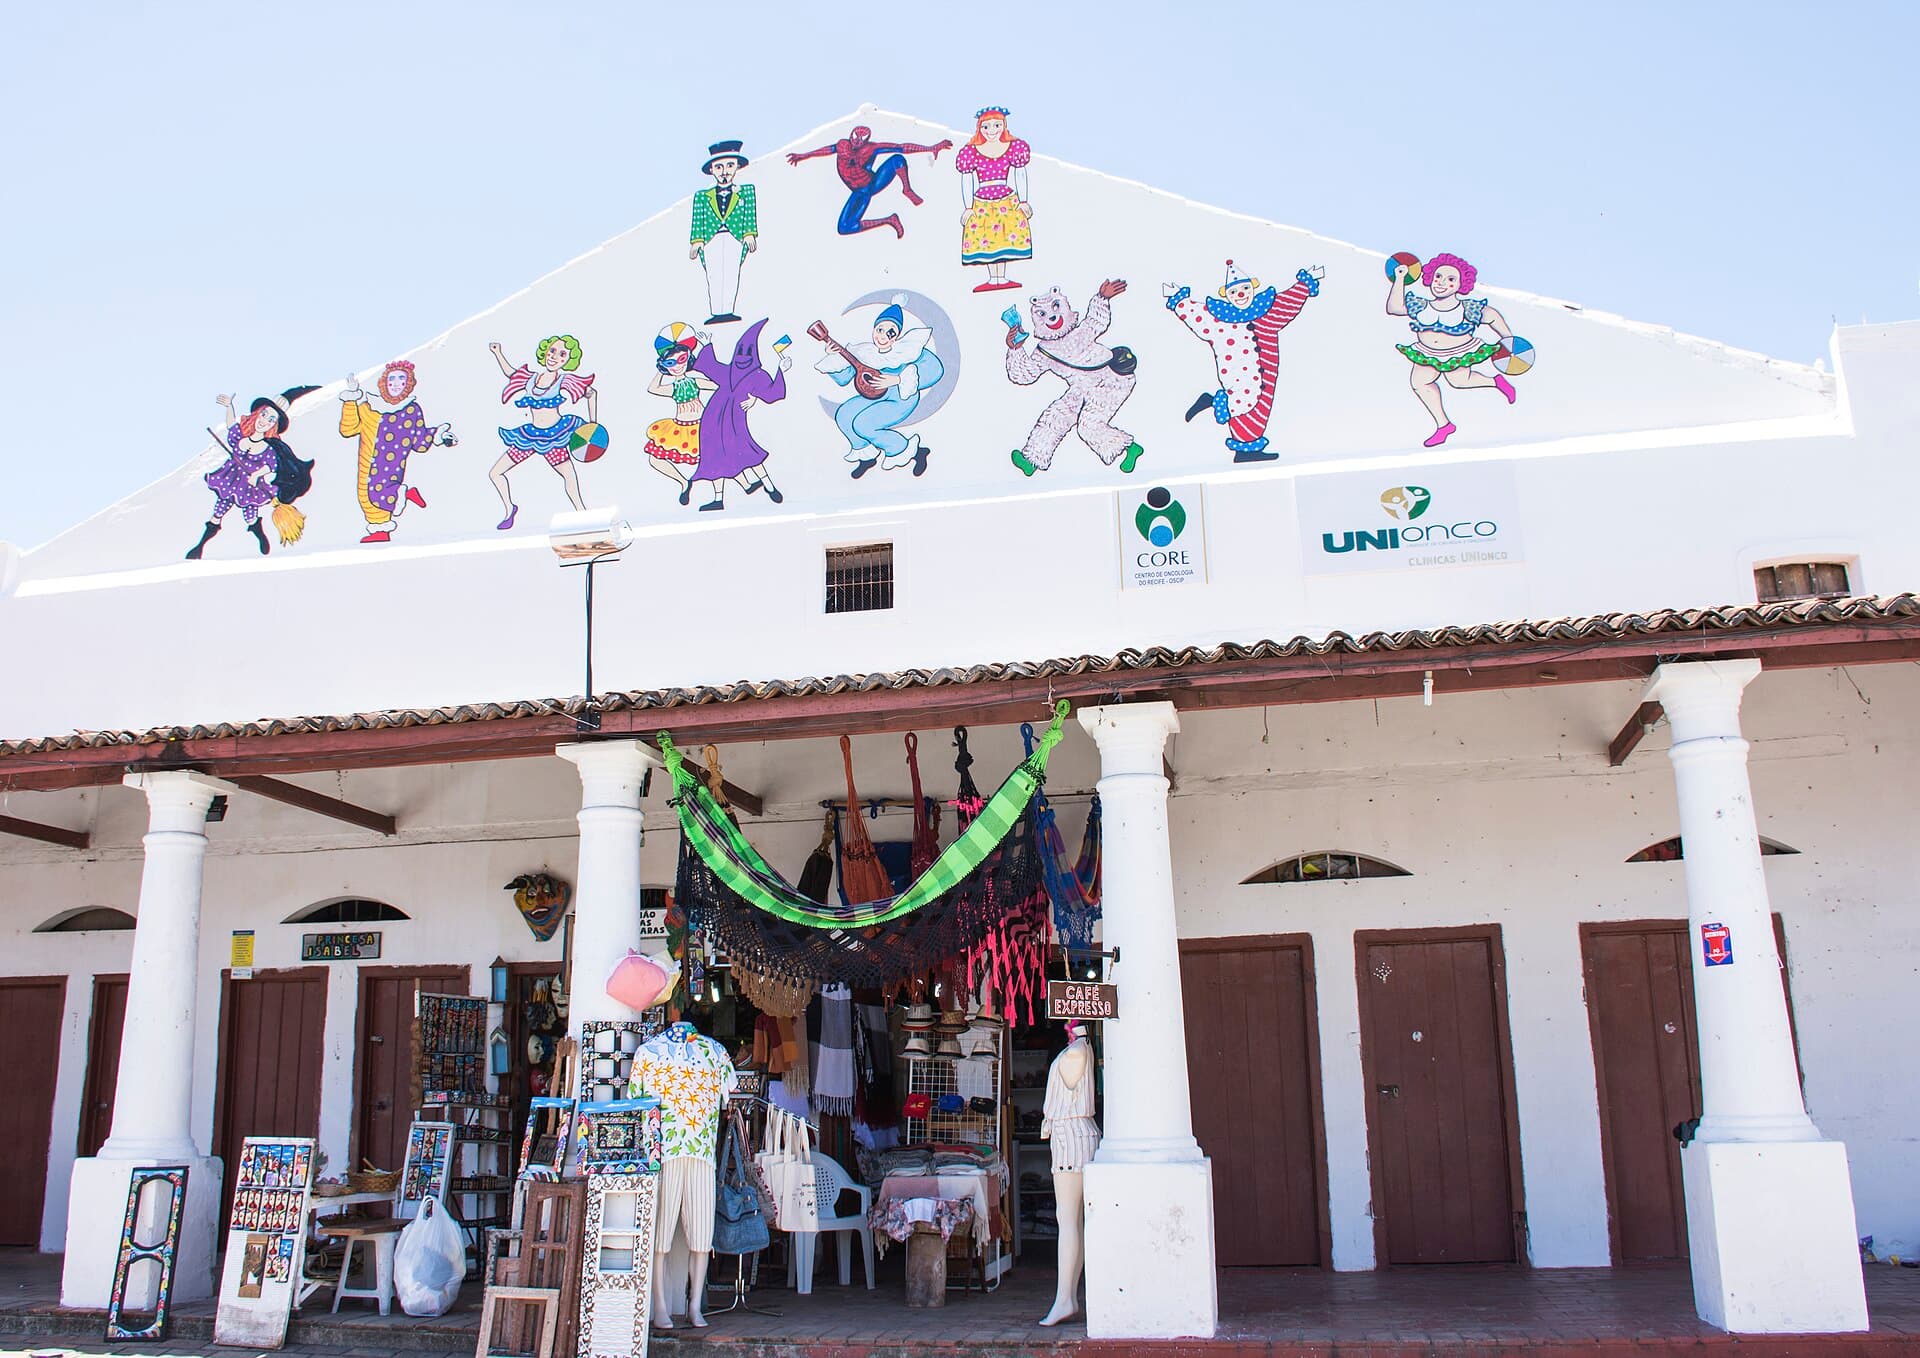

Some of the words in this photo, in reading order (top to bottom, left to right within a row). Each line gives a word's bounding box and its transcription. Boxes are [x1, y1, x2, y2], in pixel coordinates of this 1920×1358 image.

[1137, 551, 1190, 568] CORE
[1164, 569, 1194, 577] ONCOLOGIA
[317, 933, 374, 945] PRINCESA
[307, 945, 361, 957] ISABEL
[1065, 985, 1100, 1001] CAFÉ
[1054, 998, 1112, 1016] EXPRESSO
